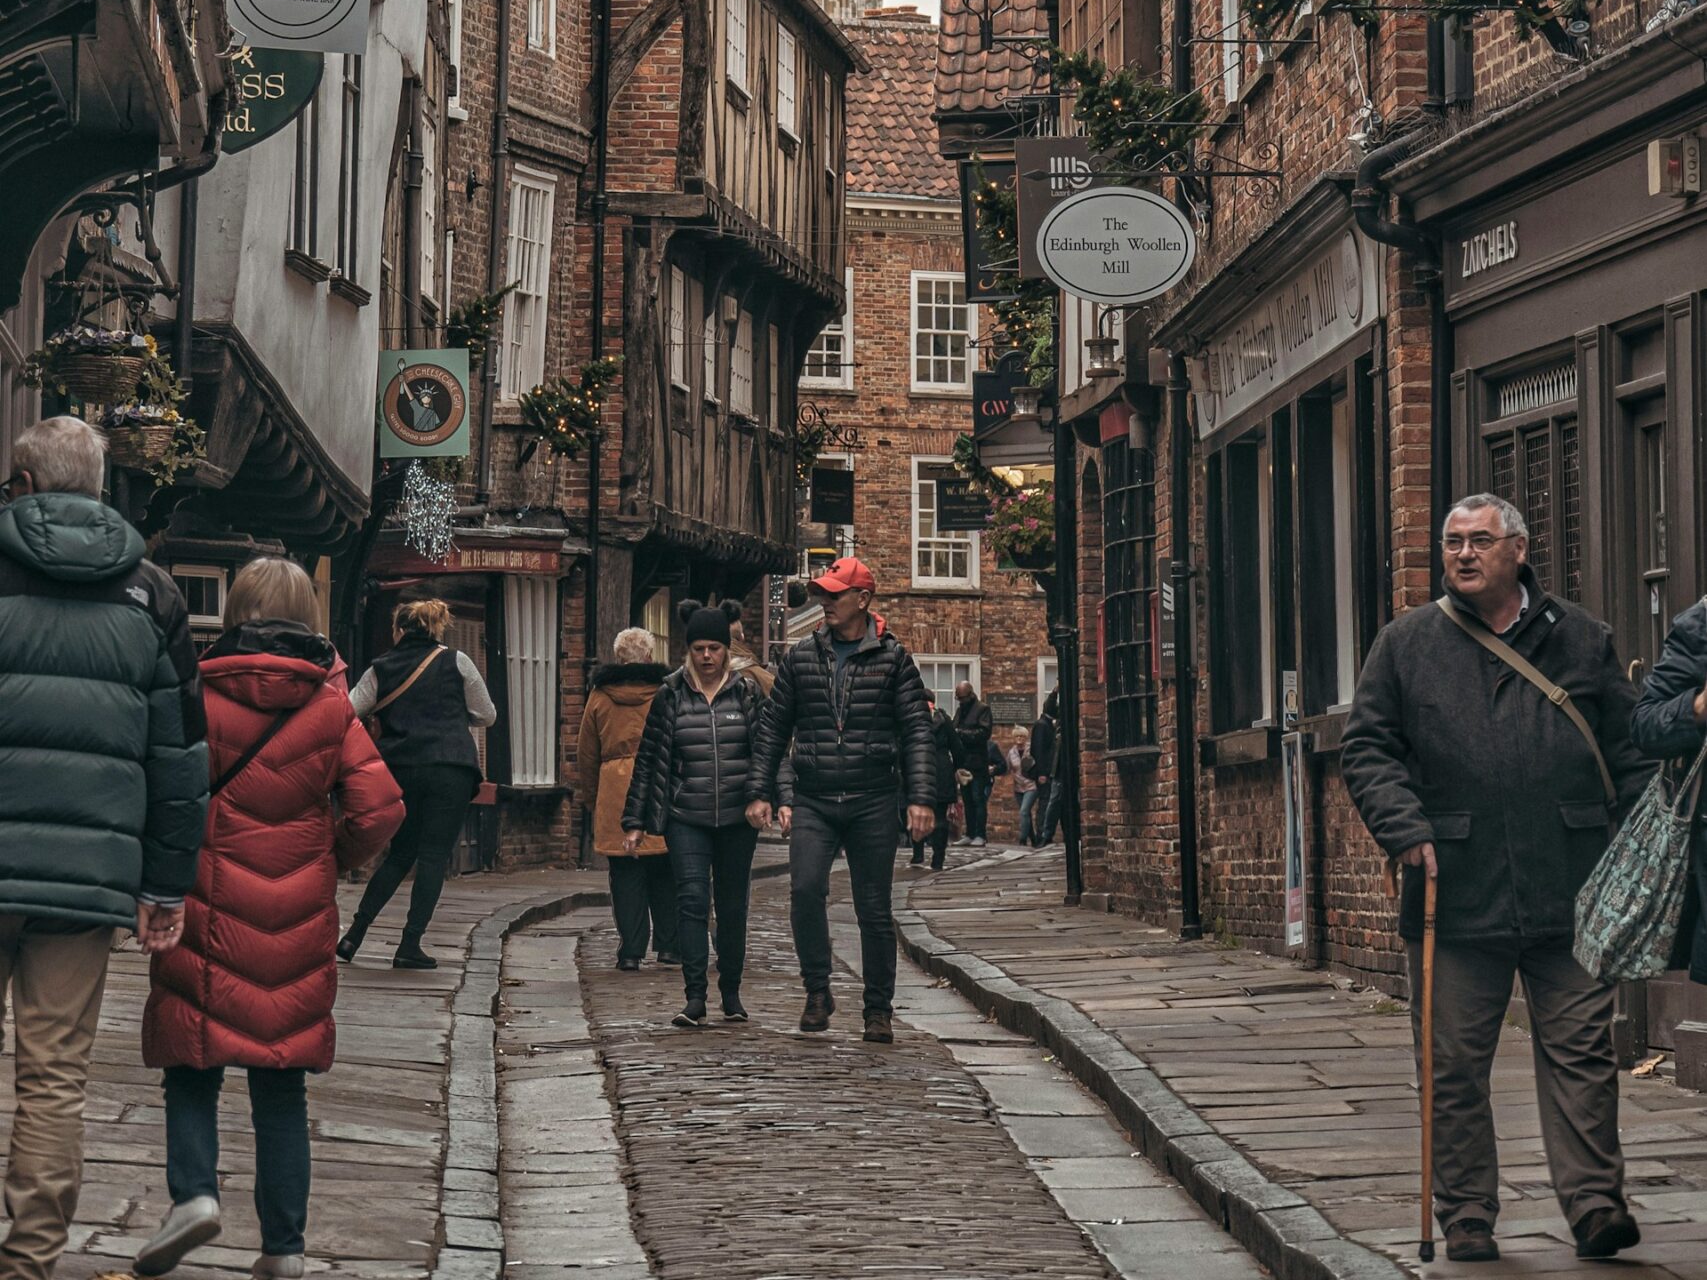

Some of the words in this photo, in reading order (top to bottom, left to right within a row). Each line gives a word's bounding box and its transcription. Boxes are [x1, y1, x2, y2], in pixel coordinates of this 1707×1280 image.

[222, 108, 256, 132] td.
[1102, 217, 1129, 231] The
[1050, 237, 1120, 255] Edinburgh
[1127, 237, 1182, 251] Woollen
[1461, 220, 1518, 278] ZATCHELS
[1102, 261, 1130, 274] Mill
[1220, 341, 1236, 398] The
[1236, 303, 1278, 381] Edinburgh
[1276, 282, 1314, 353] Woollen
[1314, 256, 1338, 331] Mill
[414, 367, 458, 393] CHEESECAKE
